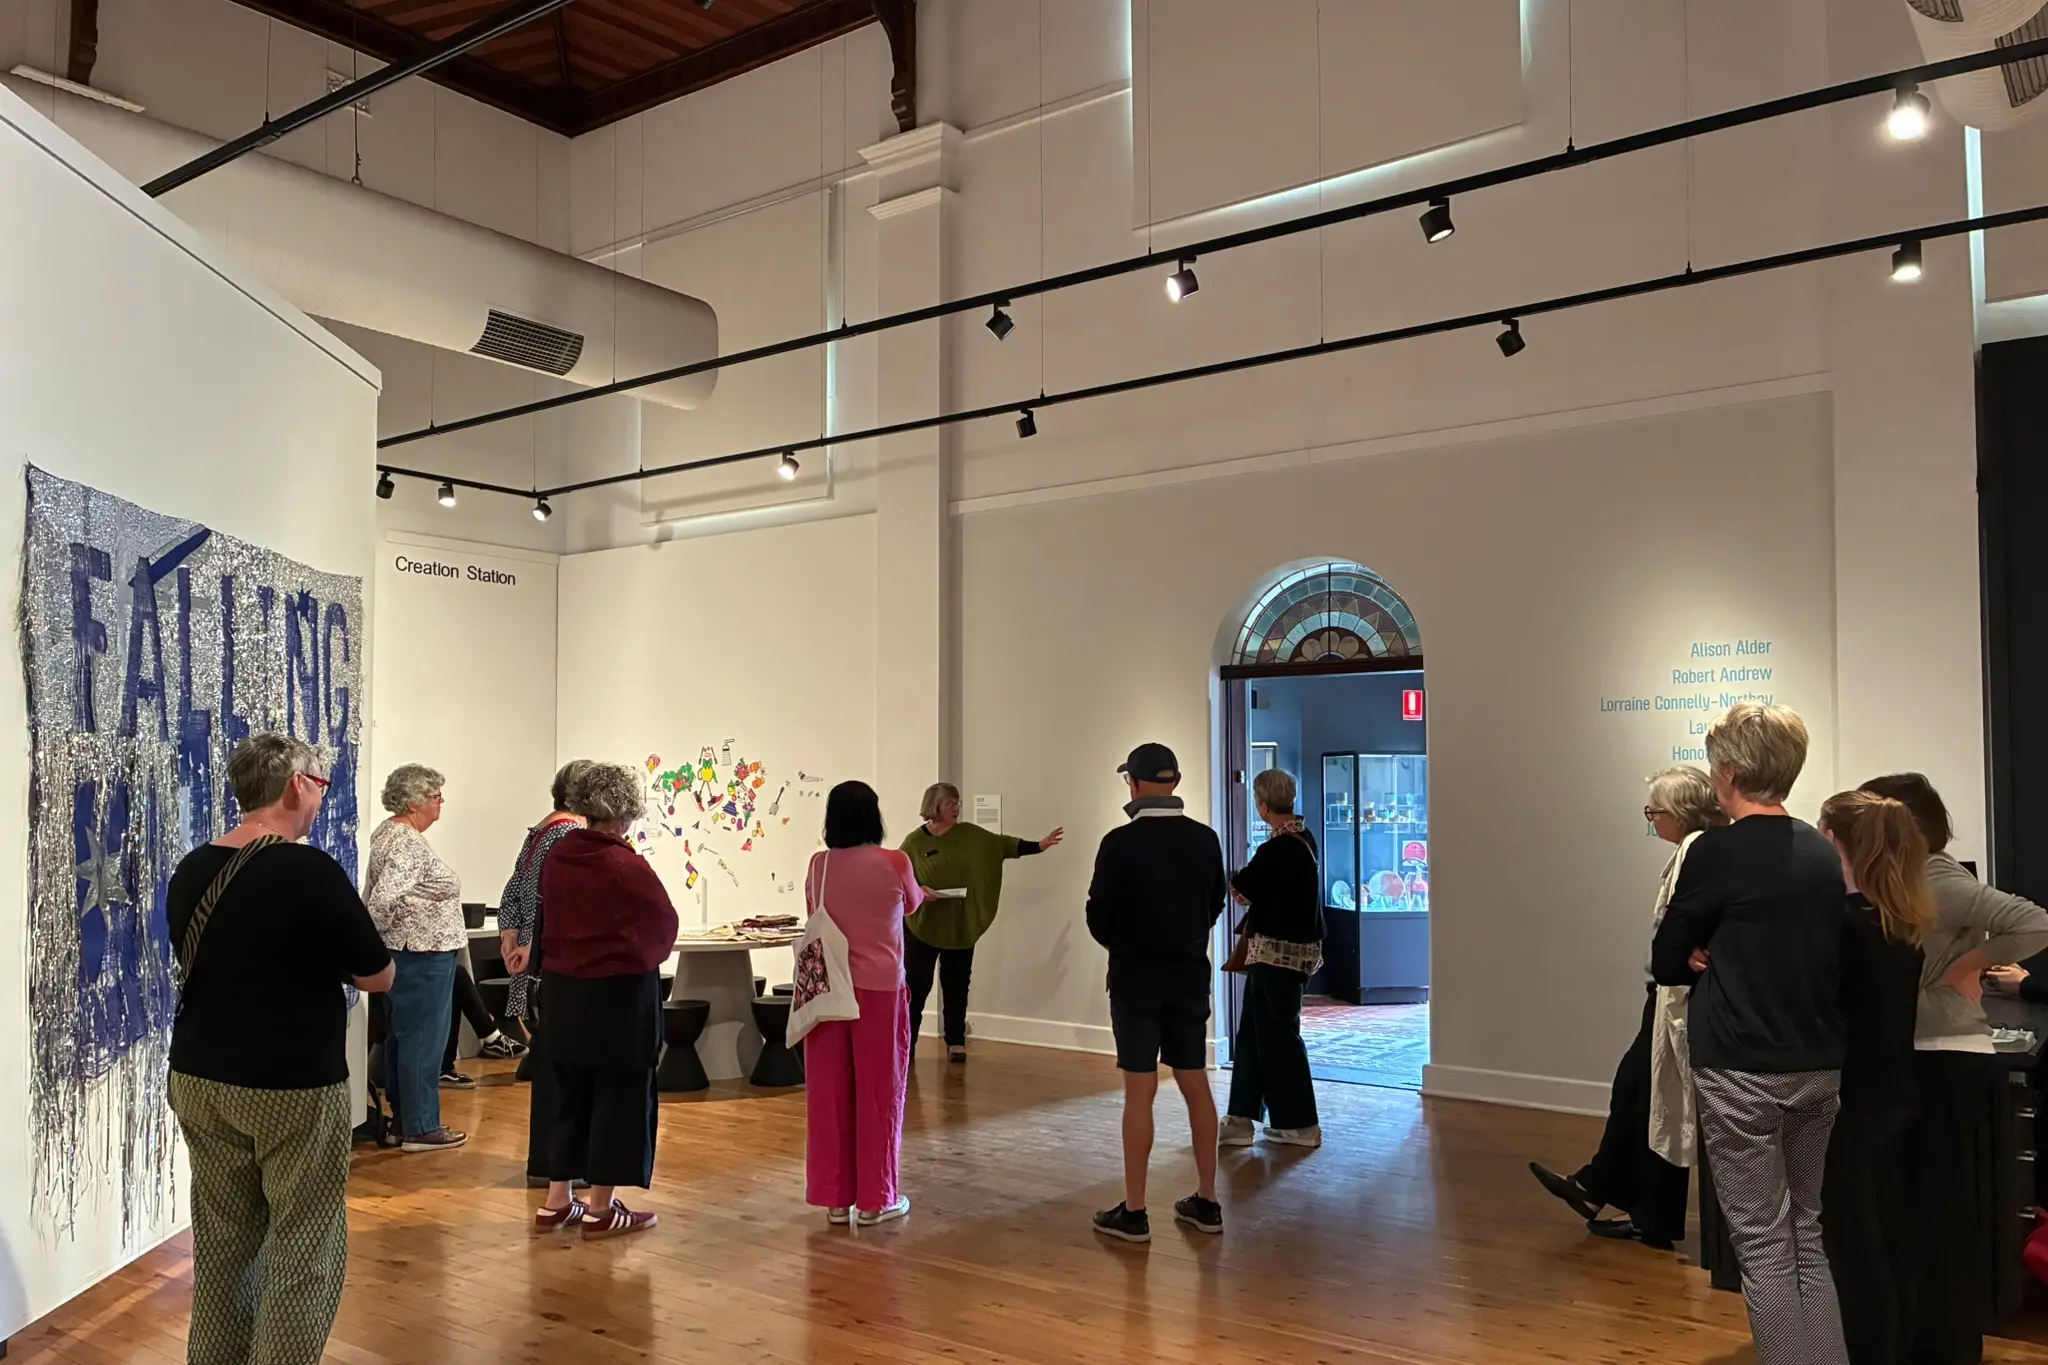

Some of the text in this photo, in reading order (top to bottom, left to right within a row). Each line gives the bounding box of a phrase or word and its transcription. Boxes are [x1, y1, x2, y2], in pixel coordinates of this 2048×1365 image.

[395, 556, 516, 585] Creation Station
[1691, 639, 1772, 658] Alison Alder
[1672, 665, 1772, 685] Robert Andrew
[1600, 696, 1650, 712] Lorraine
